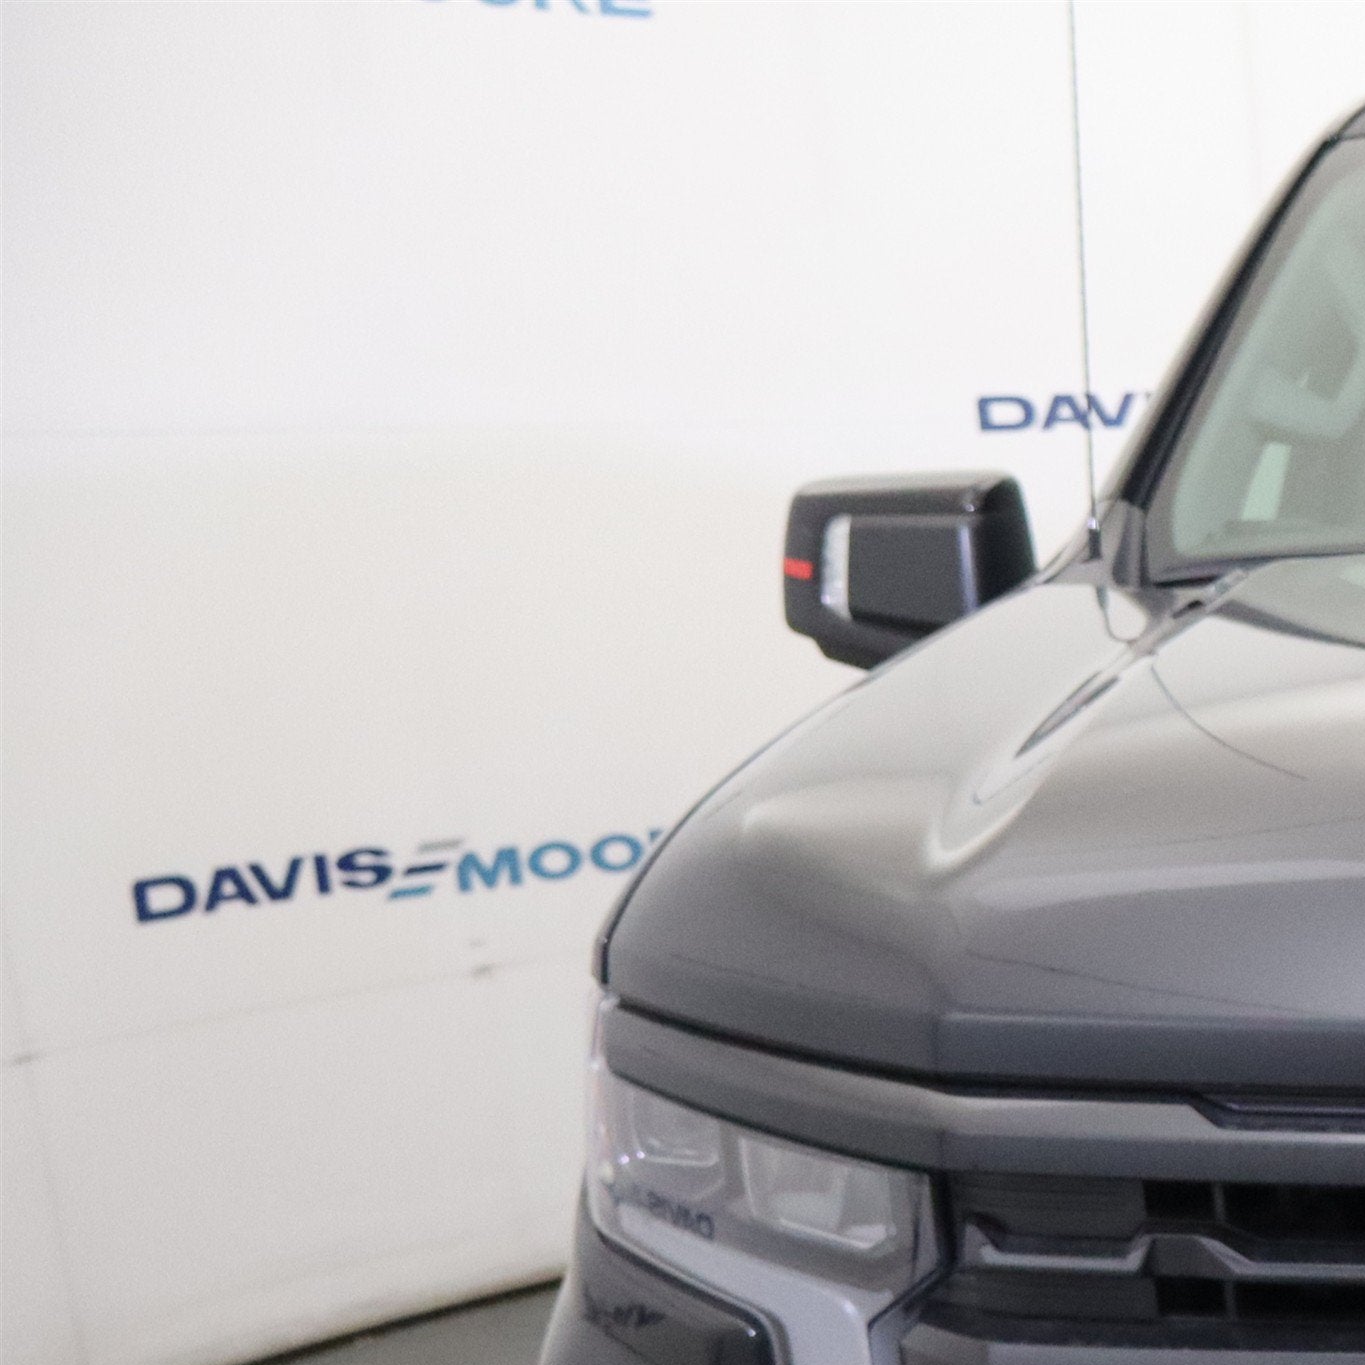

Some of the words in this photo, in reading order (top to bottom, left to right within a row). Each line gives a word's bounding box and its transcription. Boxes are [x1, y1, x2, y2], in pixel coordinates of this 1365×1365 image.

[978, 393, 1152, 430] DAV
[132, 847, 394, 923] DAVIS
[456, 828, 663, 893] MOO
